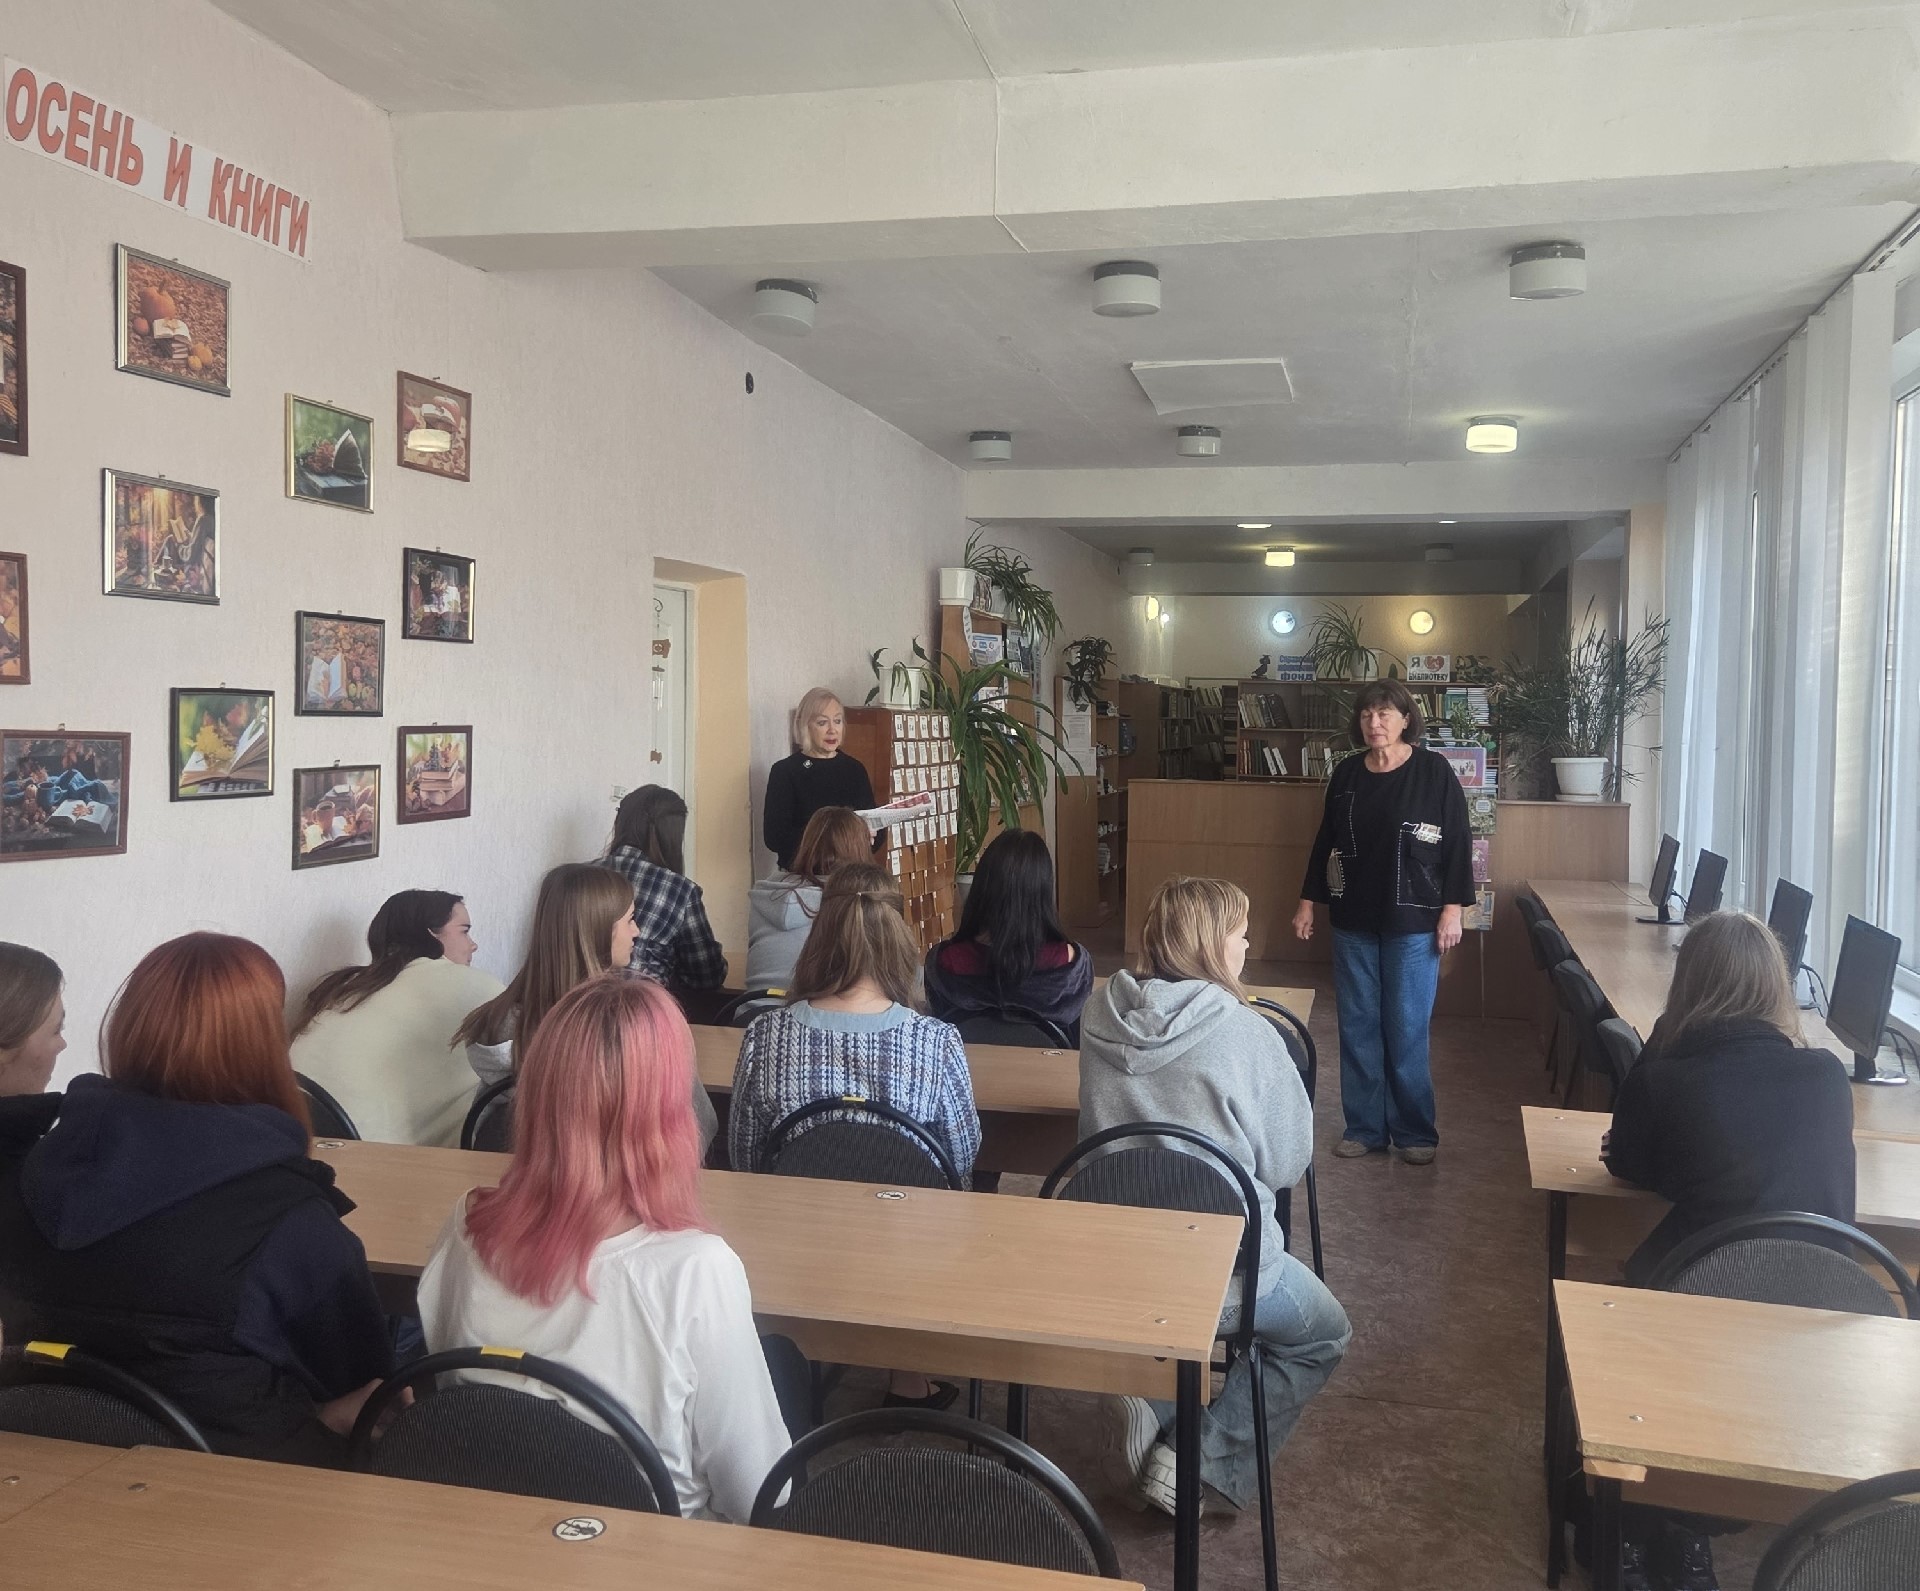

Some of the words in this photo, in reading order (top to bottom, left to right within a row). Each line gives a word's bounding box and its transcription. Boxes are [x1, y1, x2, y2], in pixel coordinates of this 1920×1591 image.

[5, 67, 144, 187] ОСЕНЬ
[163, 136, 193, 208] И
[207, 157, 309, 257] КНИГИ
[1411, 656, 1420, 668] Я
